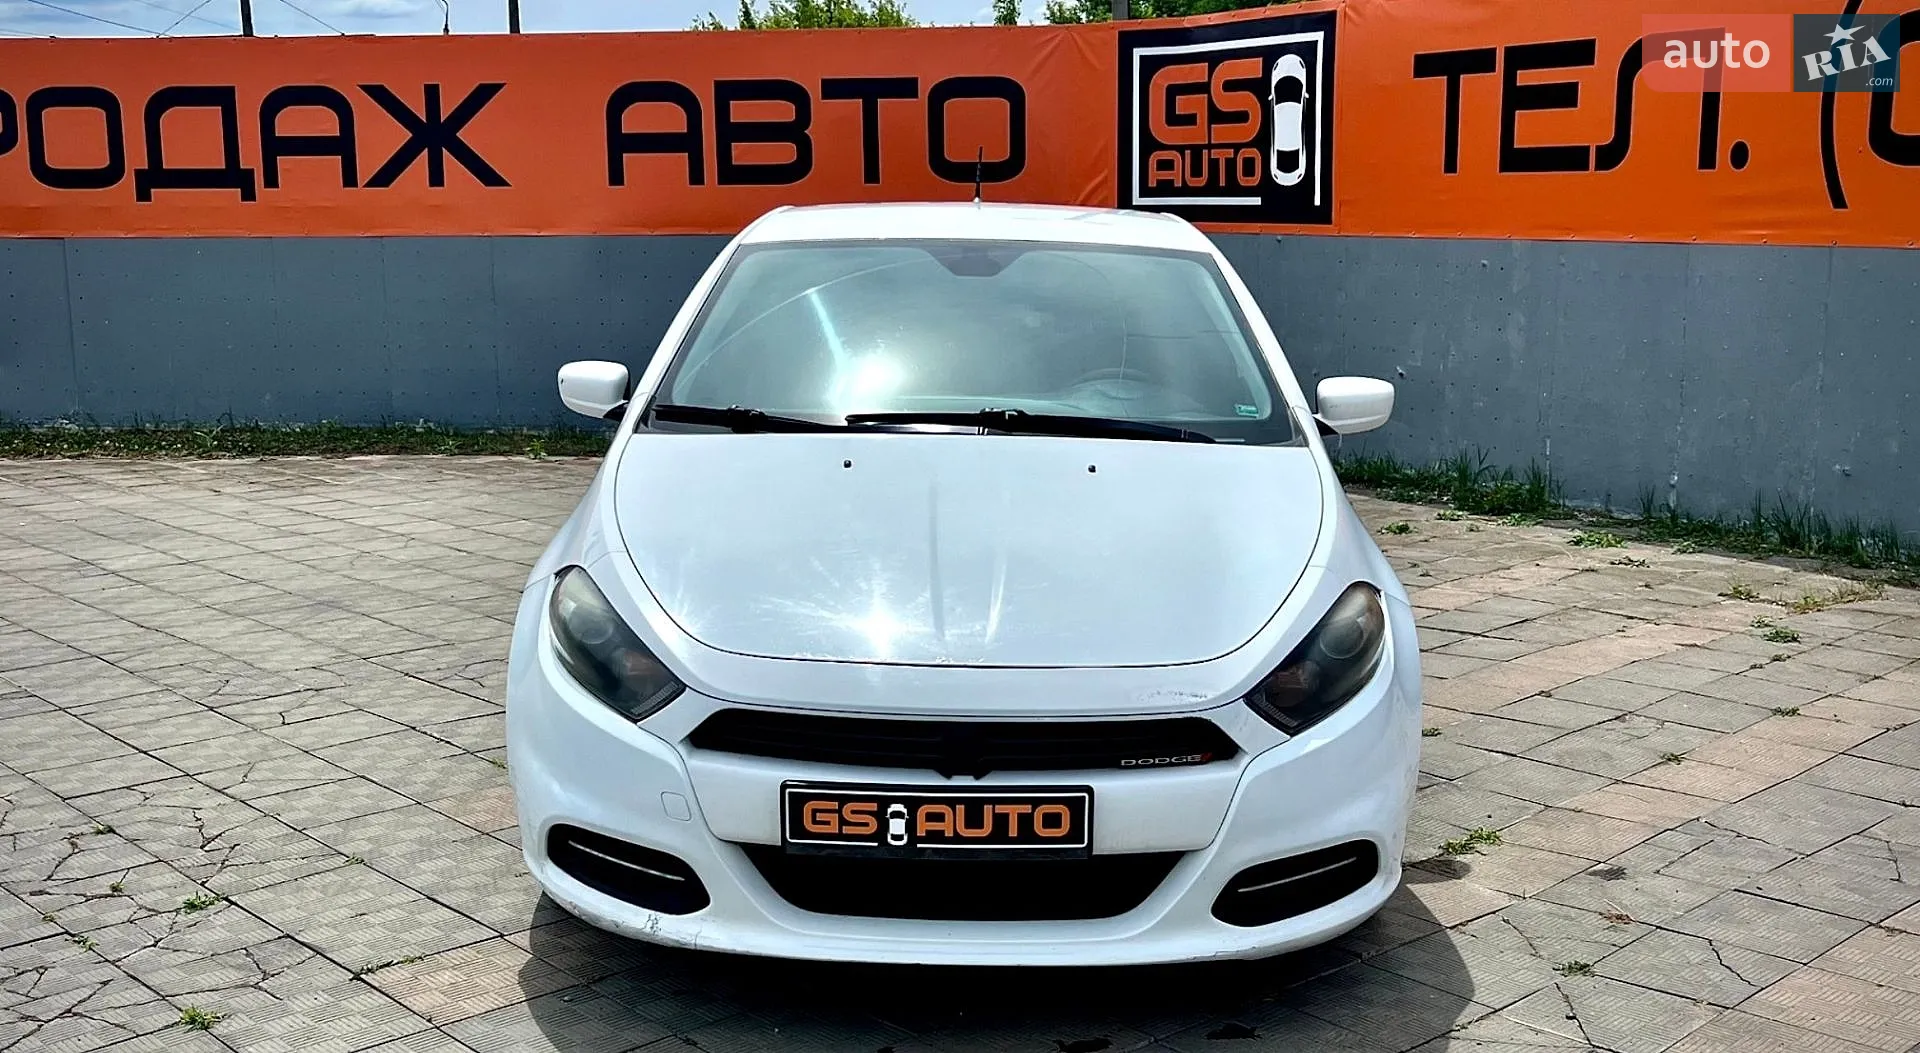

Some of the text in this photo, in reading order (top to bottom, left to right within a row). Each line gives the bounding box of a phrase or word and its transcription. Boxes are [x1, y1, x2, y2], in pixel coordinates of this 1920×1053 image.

[1149, 57, 1263, 145] GS
[1412, 26, 1750, 174] ТЕЛ.
[0, 75, 1027, 203] ОДАЖ АВТО
[1148, 148, 1262, 188] AUTO
[1121, 754, 1201, 766] DODGE
[803, 800, 1070, 837] GS AUTO
